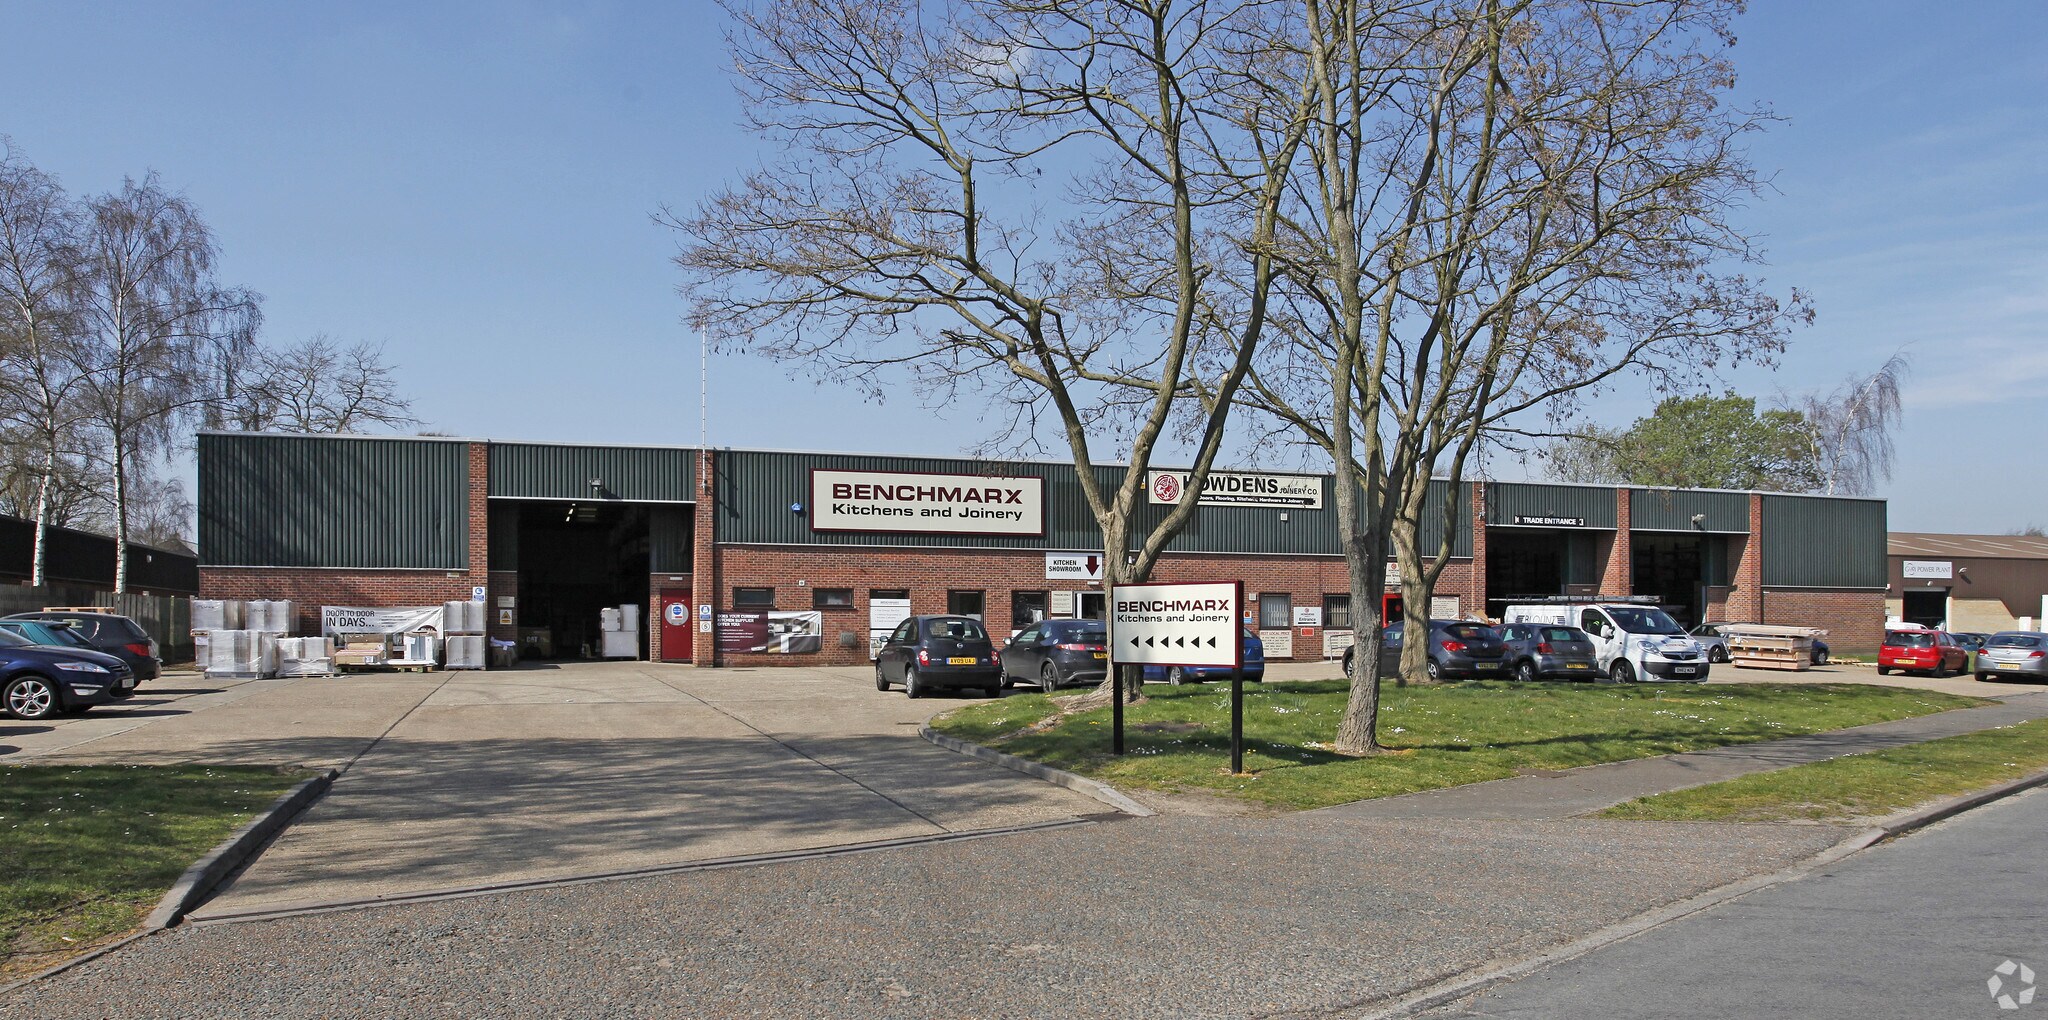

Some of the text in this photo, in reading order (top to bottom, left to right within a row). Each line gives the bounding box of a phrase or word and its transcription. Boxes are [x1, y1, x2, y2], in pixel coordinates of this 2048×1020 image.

[832, 483, 1023, 505] BENCHMARX
[1279, 487, 1306, 495] JOINERY
[1307, 488, 1319, 496] CO.
[832, 503, 1023, 521] Kitchens and Joinery
[1544, 517, 1577, 525] ENTRANCE
[1117, 599, 1230, 613] BENCHMARX
[325, 609, 345, 617] DOOR
[1117, 613, 1230, 624] Kitchens and Joinery
[325, 617, 336, 627] IN
[339, 617, 375, 628] DAYS...
